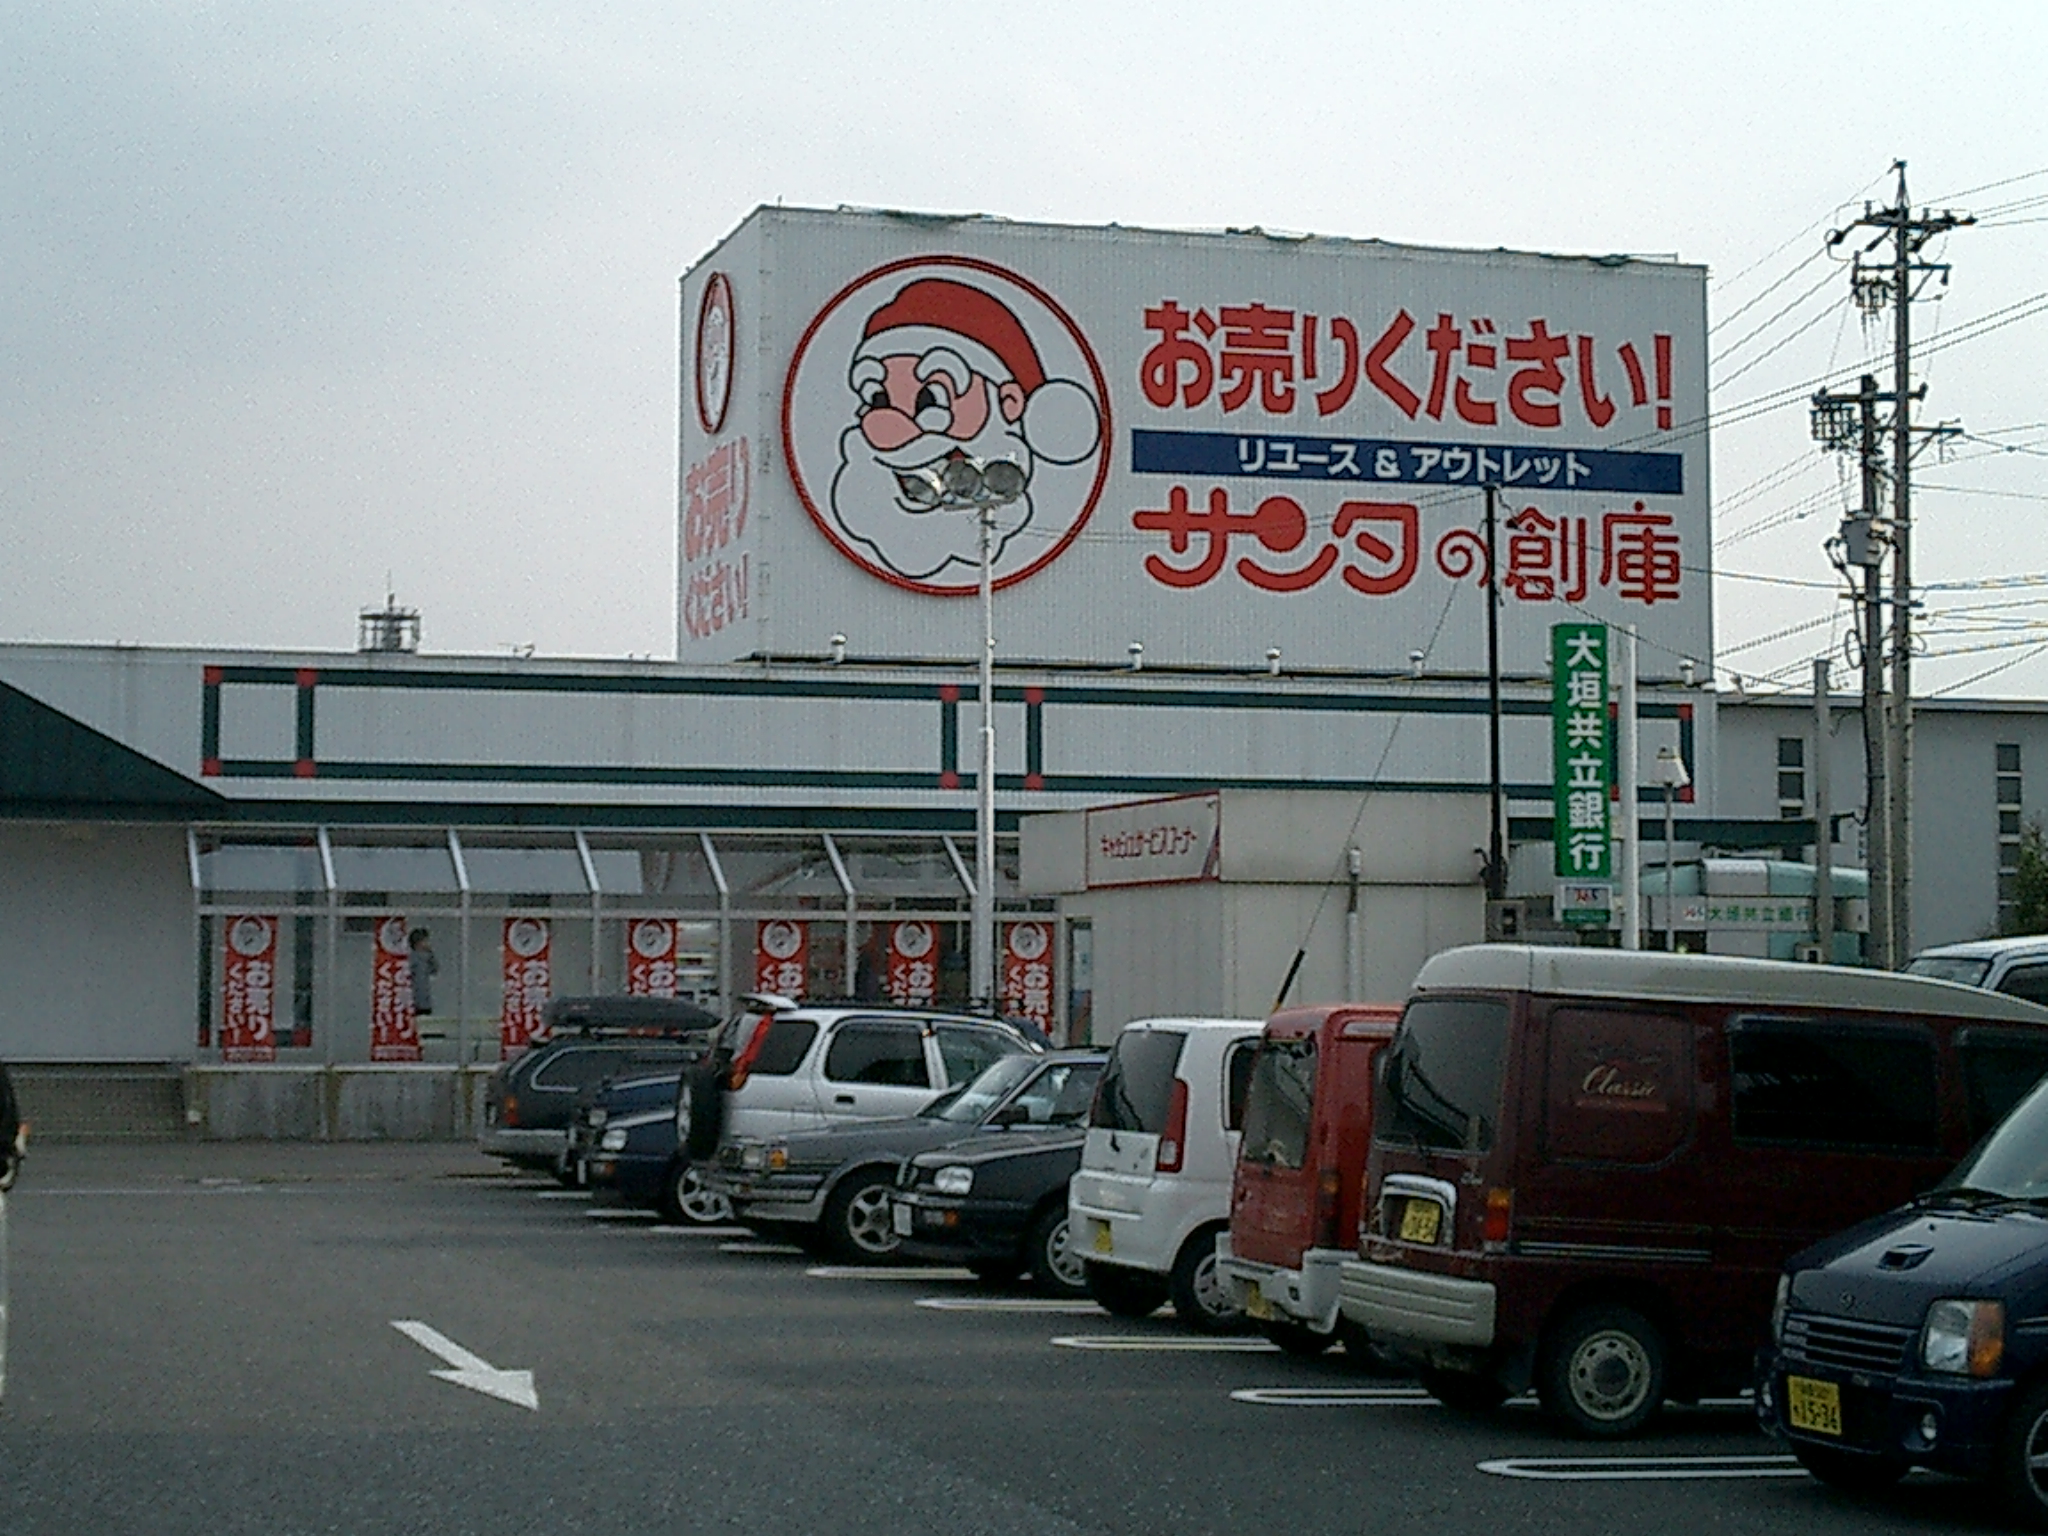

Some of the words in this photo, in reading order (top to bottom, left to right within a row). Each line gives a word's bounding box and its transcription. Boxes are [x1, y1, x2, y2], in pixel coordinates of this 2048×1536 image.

[1140, 300, 1673, 431] お売りください!
[1237, 437, 1362, 476] リユース
[1375, 448, 1401, 476] &
[1410, 446, 1593, 486] アウトレット
[1132, 485, 1682, 605] サンタの創庫
[1565, 630, 1606, 872] 大垣共立銀行
